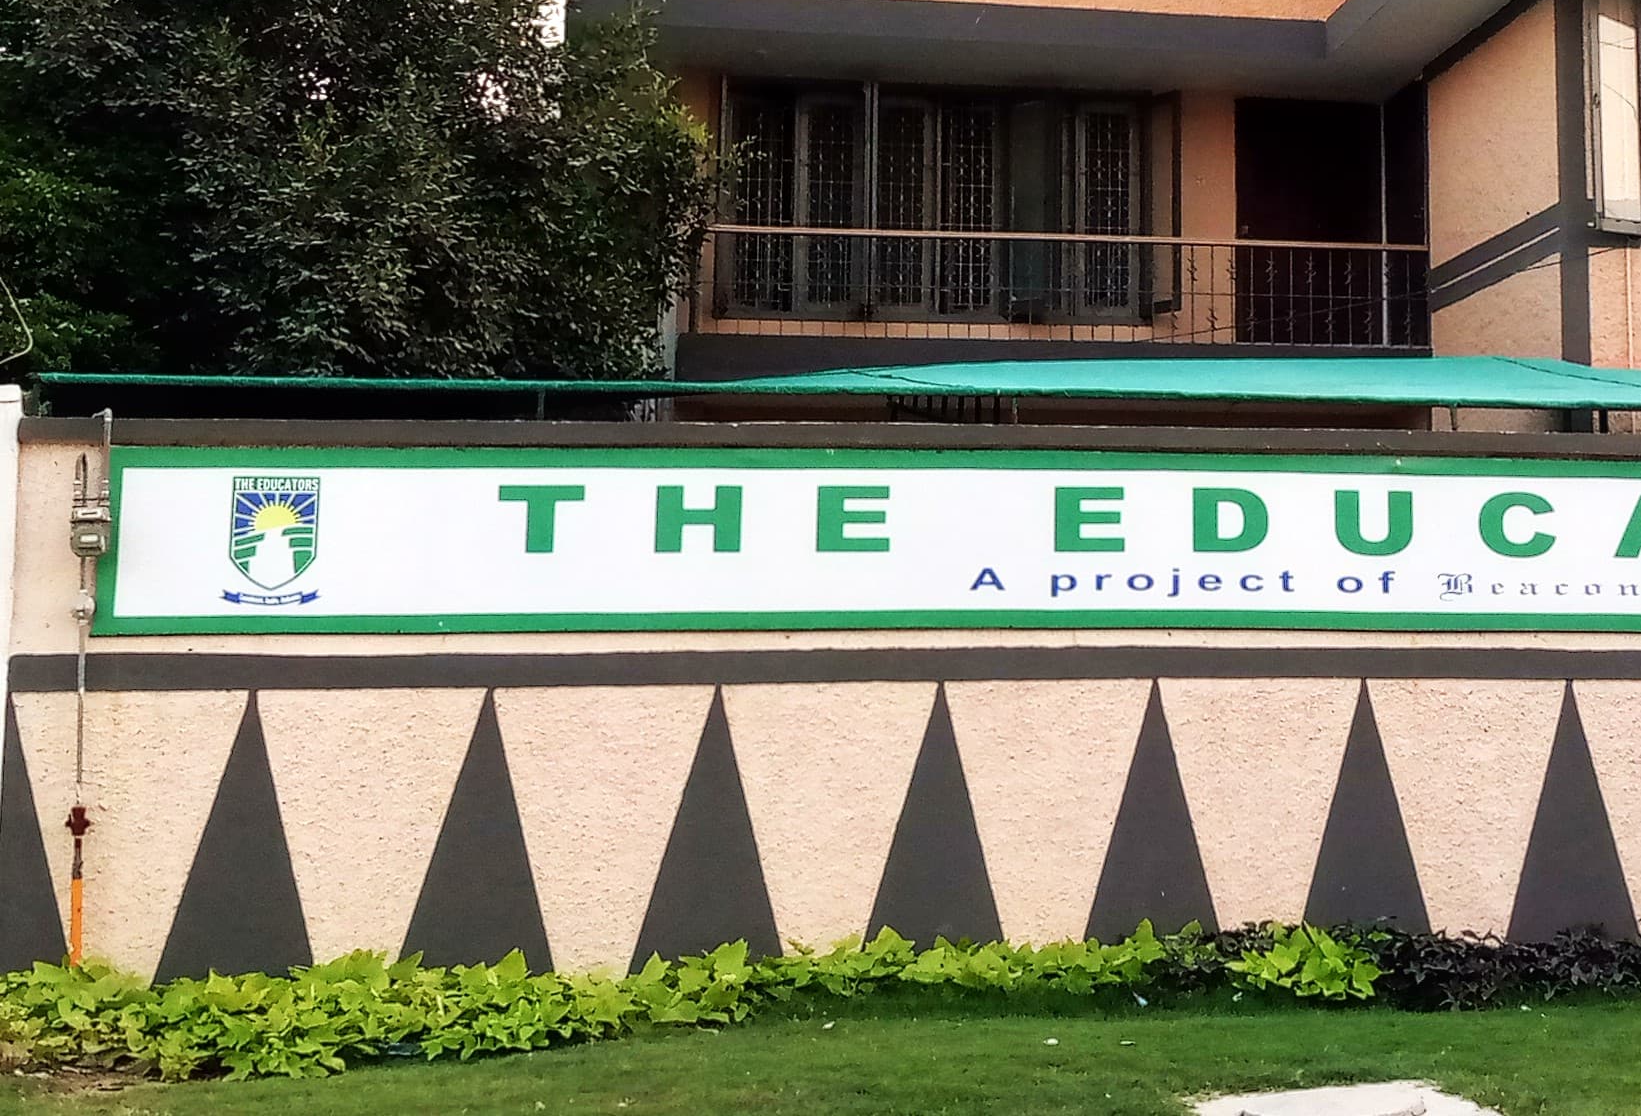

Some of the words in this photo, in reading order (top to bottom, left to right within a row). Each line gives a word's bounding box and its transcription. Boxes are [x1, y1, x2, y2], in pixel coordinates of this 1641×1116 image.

[234, 478, 256, 491] THE
[257, 478, 319, 491] EDUCATORS
[499, 485, 890, 552] THE
[970, 568, 1005, 591] A
[1050, 569, 1295, 598] project
[1336, 570, 1397, 594] of
